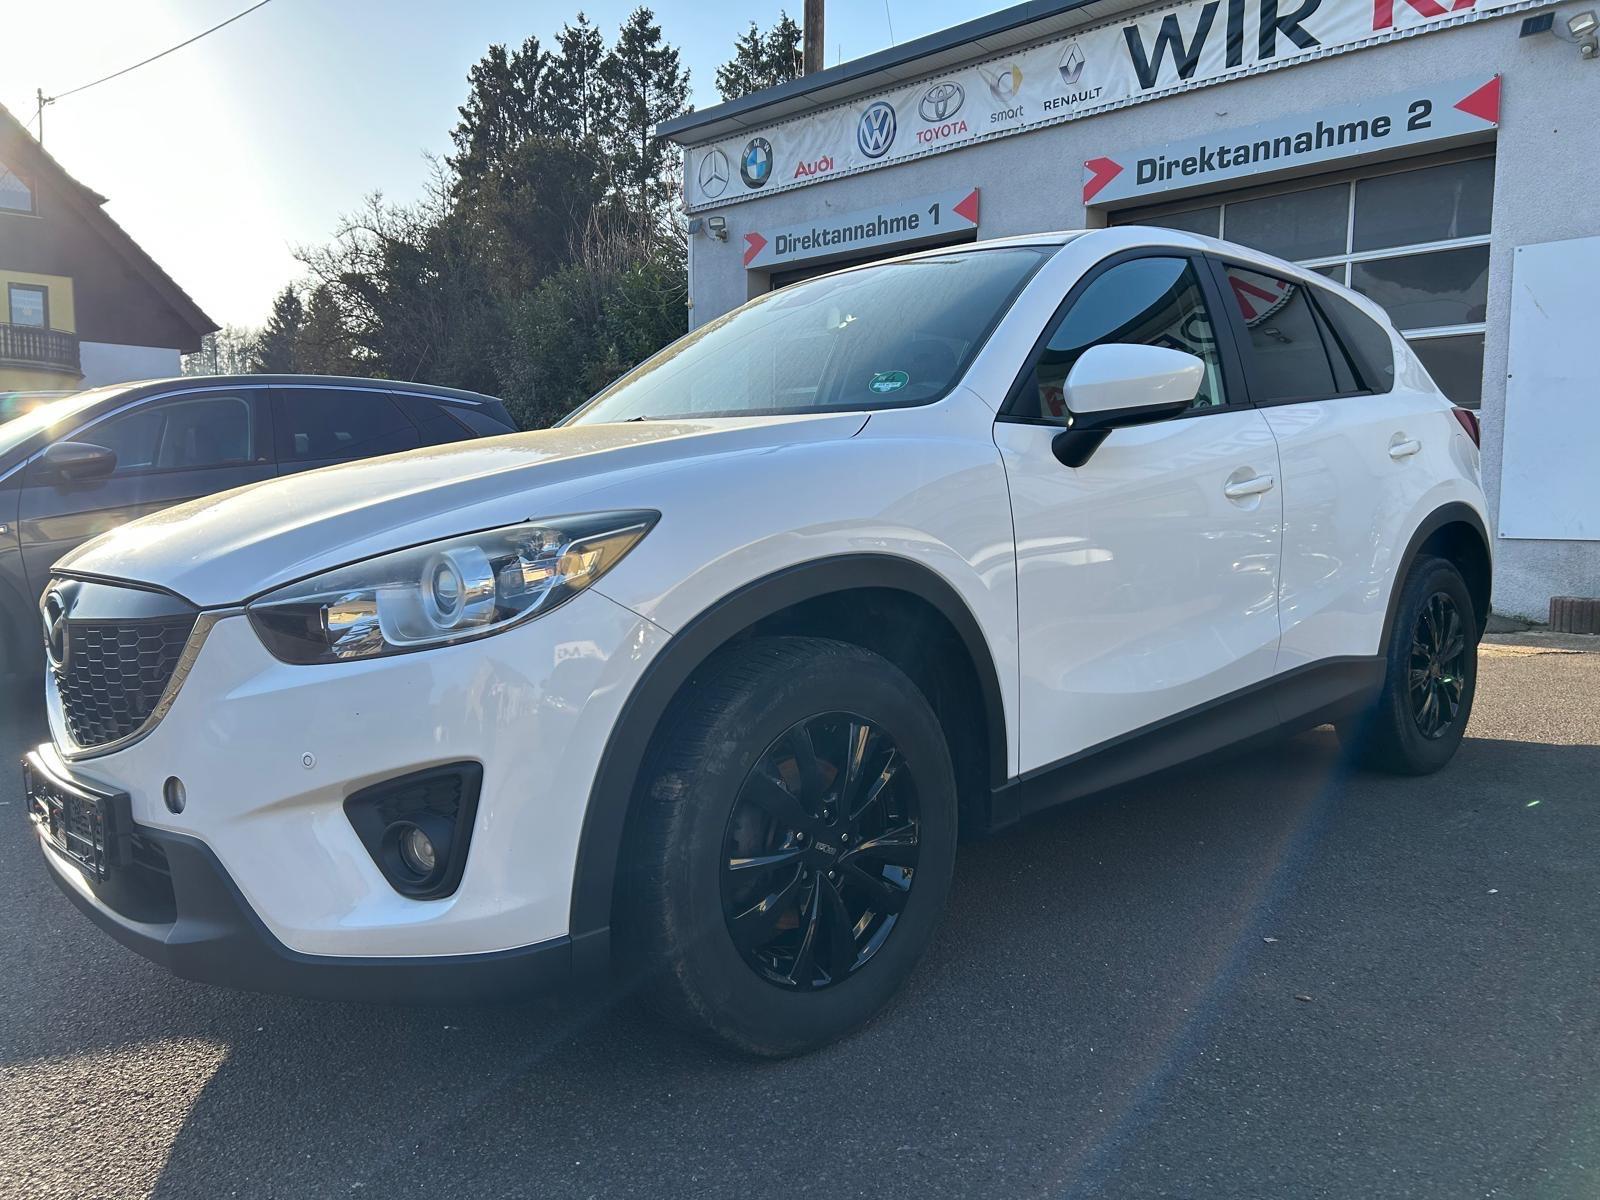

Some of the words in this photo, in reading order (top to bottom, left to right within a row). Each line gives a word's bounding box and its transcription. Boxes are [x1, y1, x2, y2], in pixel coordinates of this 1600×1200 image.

[1122, 0, 1322, 90] WIR
[1044, 87, 1102, 111] RENAULT
[990, 105, 1024, 123] smart
[916, 120, 968, 144] TOYOTA
[1136, 115, 1392, 186] Direktannahme
[1407, 99, 1432, 132] 2
[794, 154, 834, 178] Audi
[775, 210, 920, 256] Direktannahme
[928, 203, 941, 226] 1
